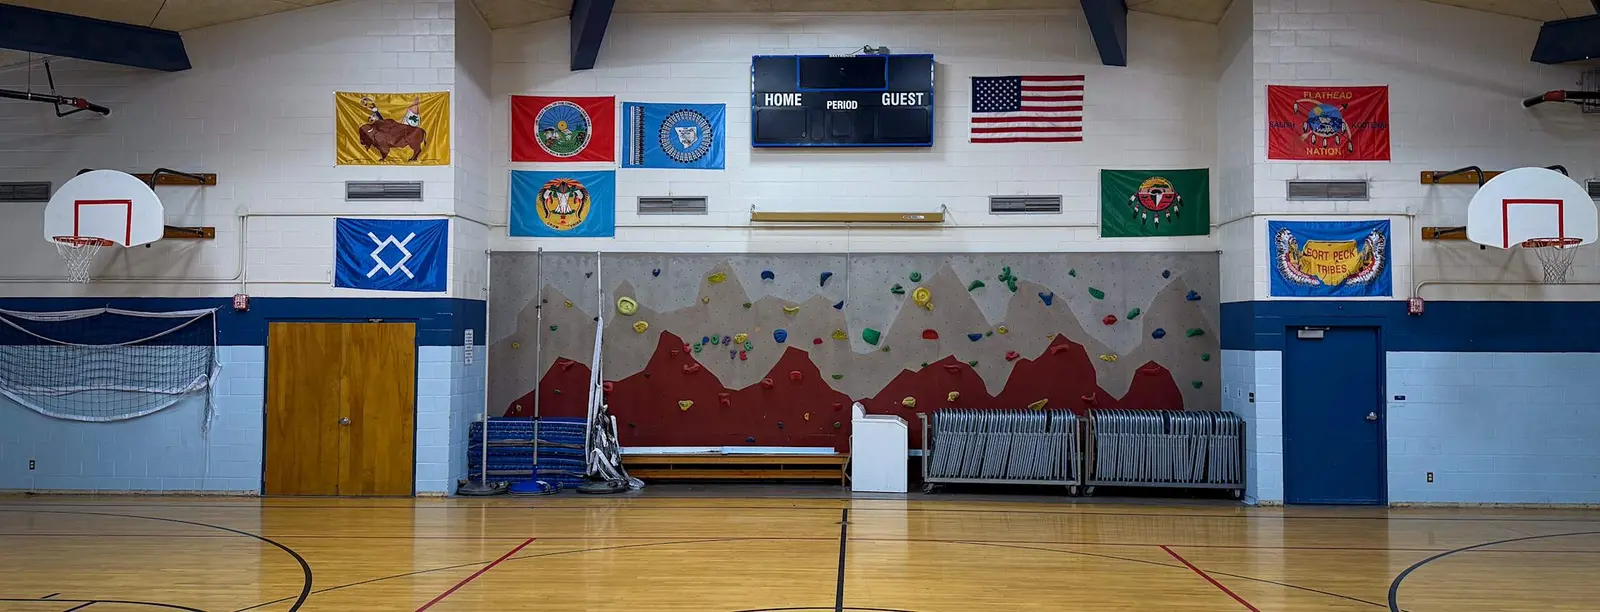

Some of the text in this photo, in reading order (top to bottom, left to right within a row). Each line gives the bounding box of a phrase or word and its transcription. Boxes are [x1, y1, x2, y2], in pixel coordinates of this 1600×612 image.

[765, 93, 802, 106] HOME
[881, 92, 924, 106] GUEST
[1303, 91, 1353, 99] FLATHEAD
[826, 100, 858, 110] PERIOD
[1306, 147, 1342, 156] NATION
[1333, 247, 1356, 260] PECK
[1316, 264, 1347, 275] TRIBES
